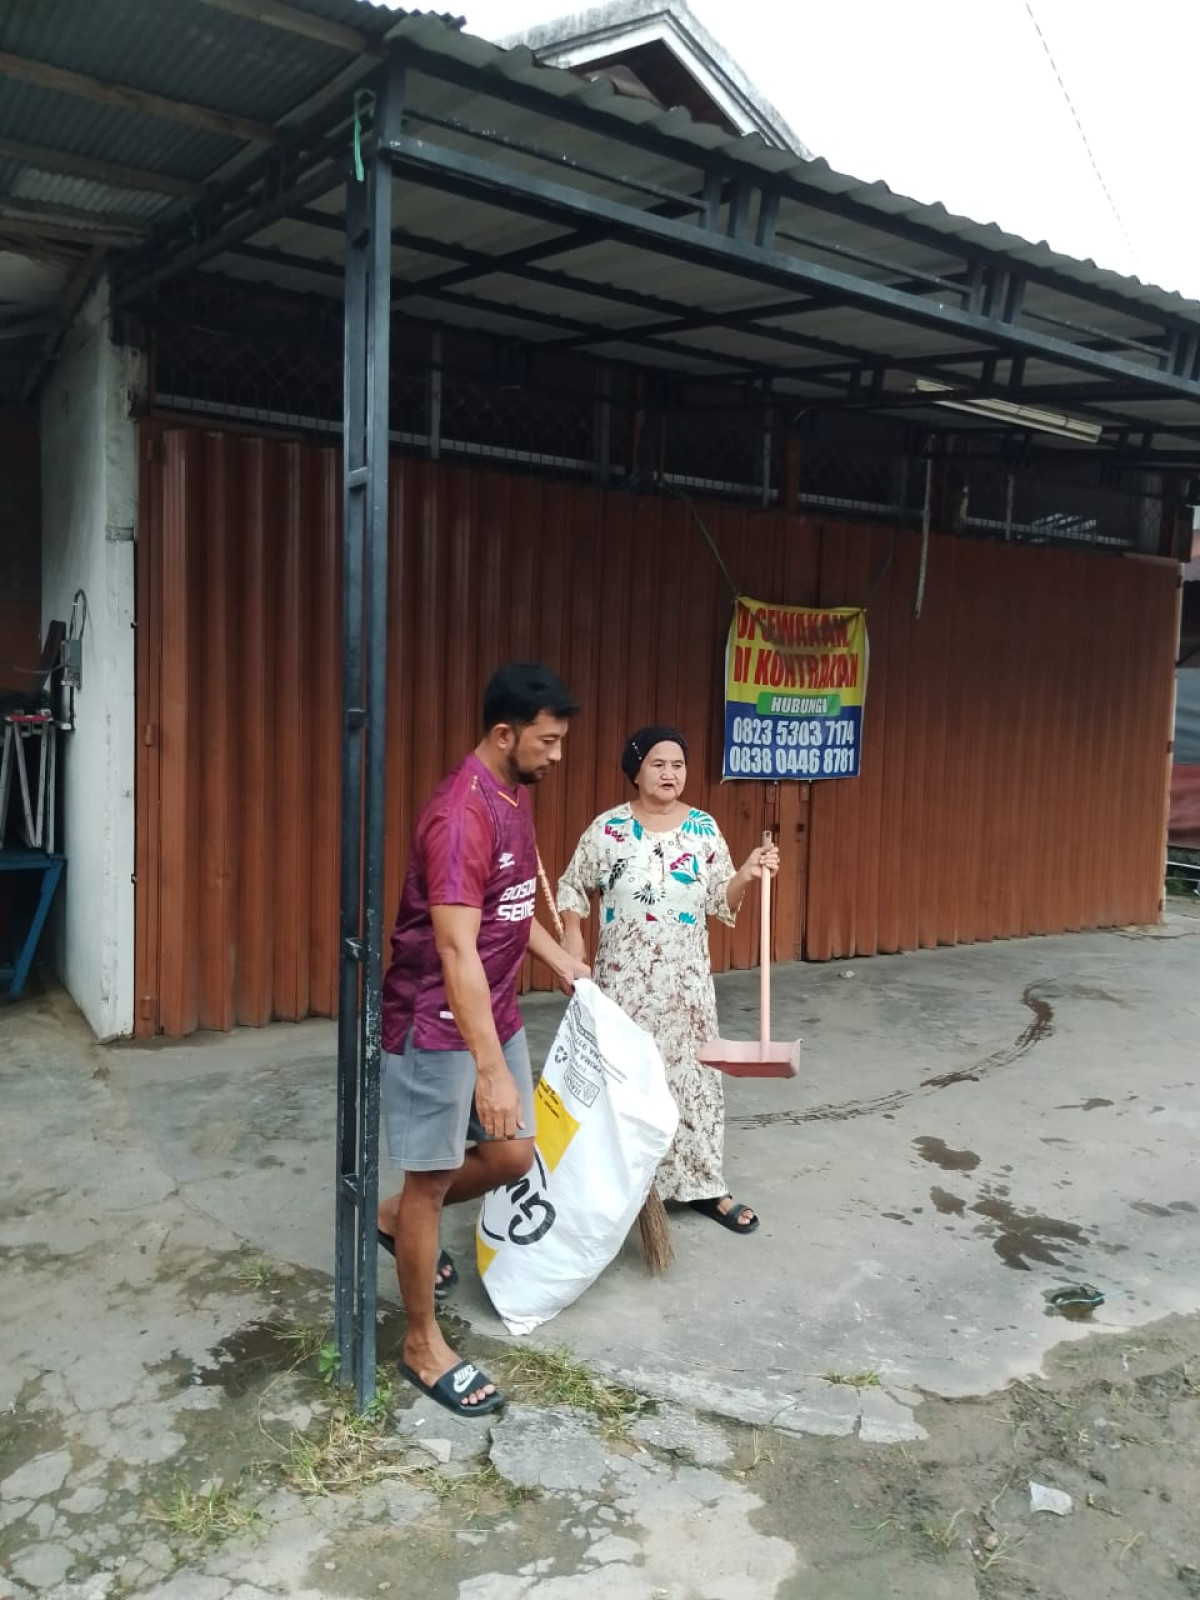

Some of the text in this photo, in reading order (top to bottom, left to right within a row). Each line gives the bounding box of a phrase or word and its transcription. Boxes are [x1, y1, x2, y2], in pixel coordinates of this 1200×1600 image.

[737, 602, 756, 641] DI
[734, 645, 858, 689] DI KONTRAKAN
[771, 696, 828, 714] HUBUNGI
[733, 717, 854, 746] 0823 5303 7174
[730, 745, 854, 774] 0838 0446 8781
